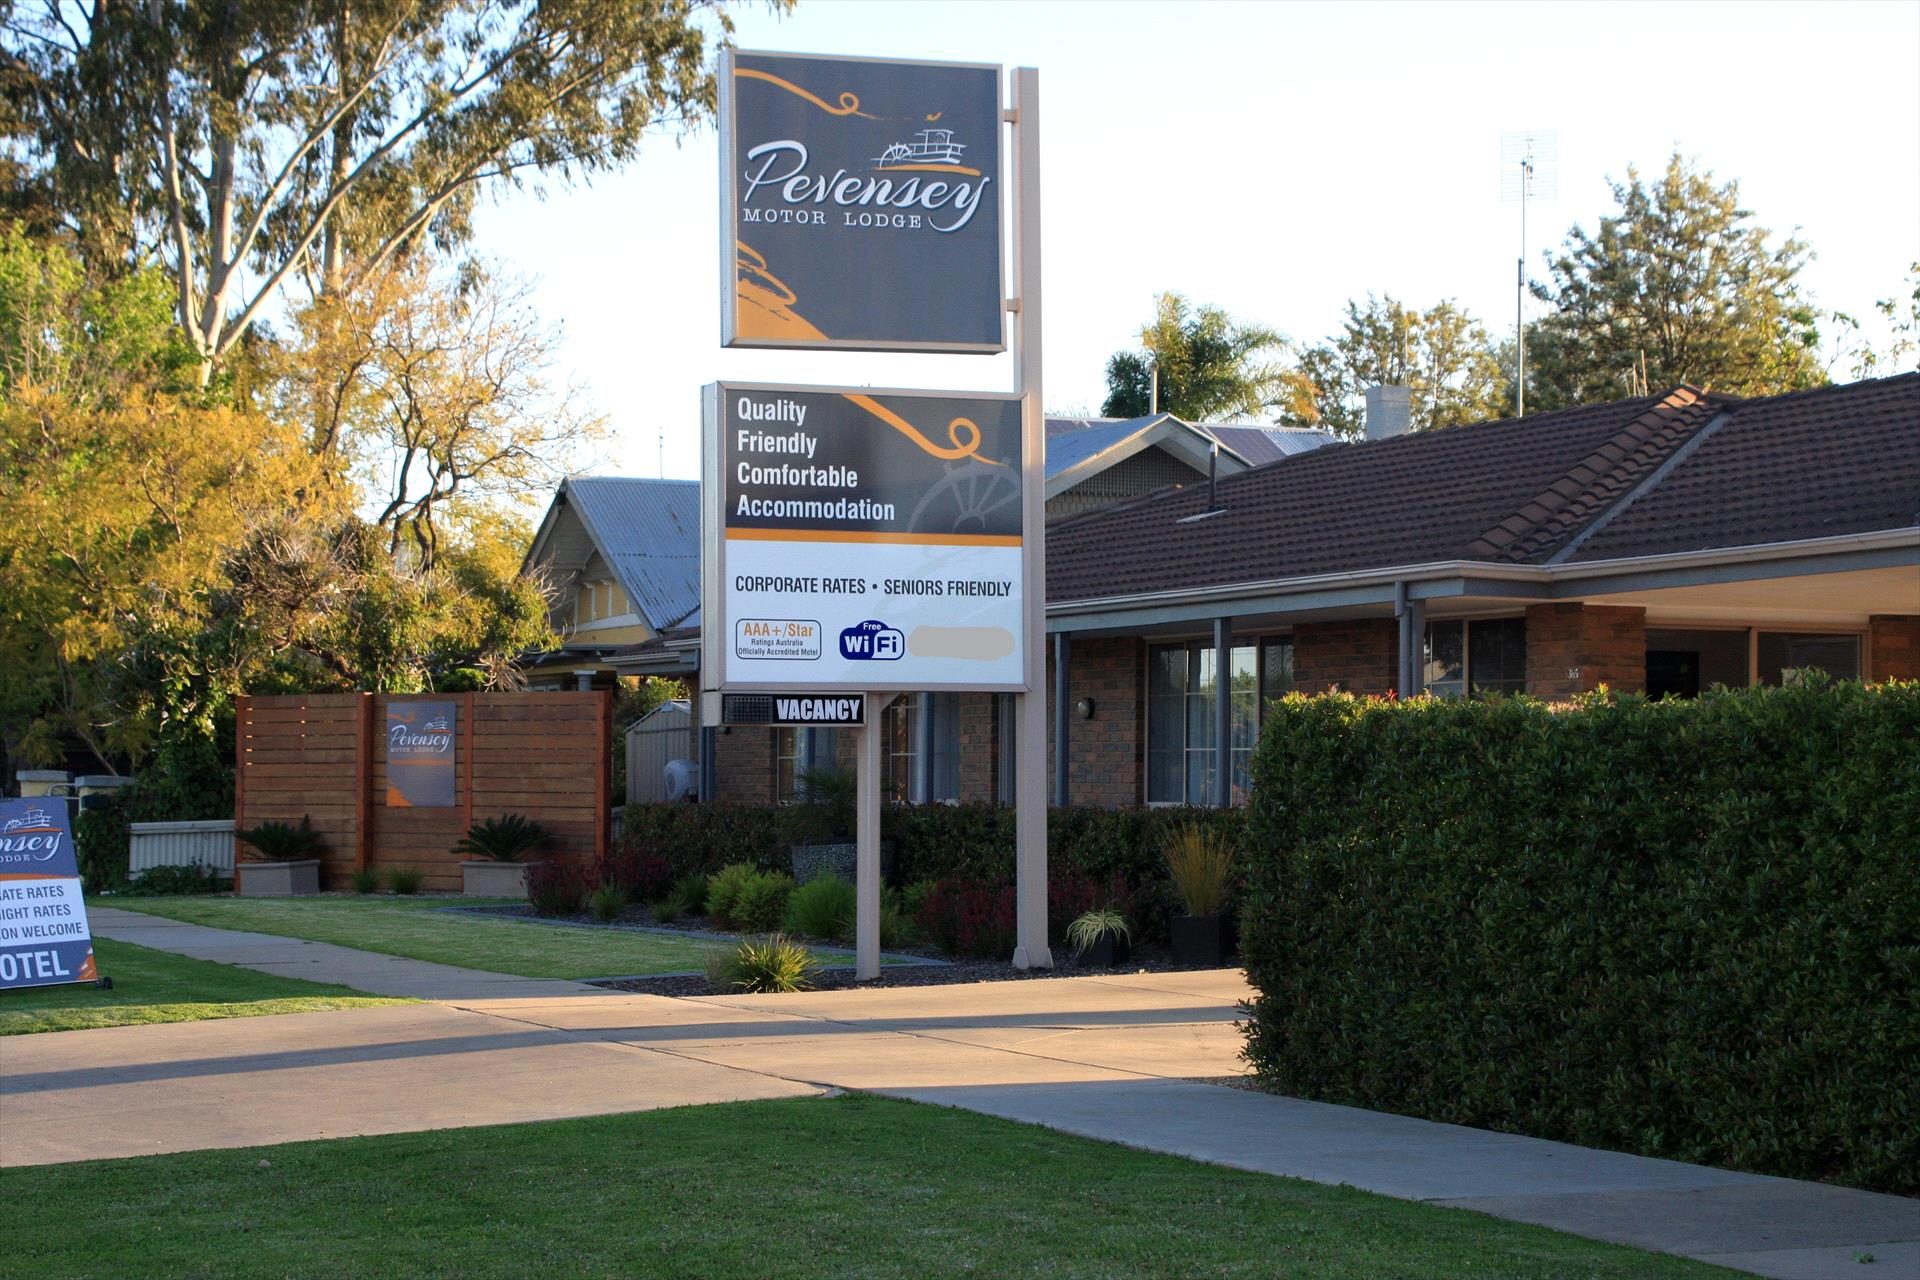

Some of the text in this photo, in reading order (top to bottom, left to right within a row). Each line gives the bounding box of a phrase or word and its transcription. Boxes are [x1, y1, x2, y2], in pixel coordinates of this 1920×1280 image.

[744, 140, 991, 233] Pevensey
[743, 208, 922, 229] MOTOR LODGE
[737, 397, 807, 426] Quality
[737, 430, 818, 459] Friendly
[737, 462, 858, 488] Comfortable
[736, 495, 896, 521] Accommodation
[735, 576, 1012, 597] CORPORATE RATES SENIORS FRIENDLY
[863, 622, 882, 630] Free
[738, 647, 818, 656] Officially Accredited Motel
[751, 638, 804, 647] Ratings Australia
[776, 698, 861, 720] VACANCY
[0, 885, 65, 901] ATE RATES
[0, 903, 72, 920] IGHT RATES
[0, 921, 83, 940] ON WELCOME
